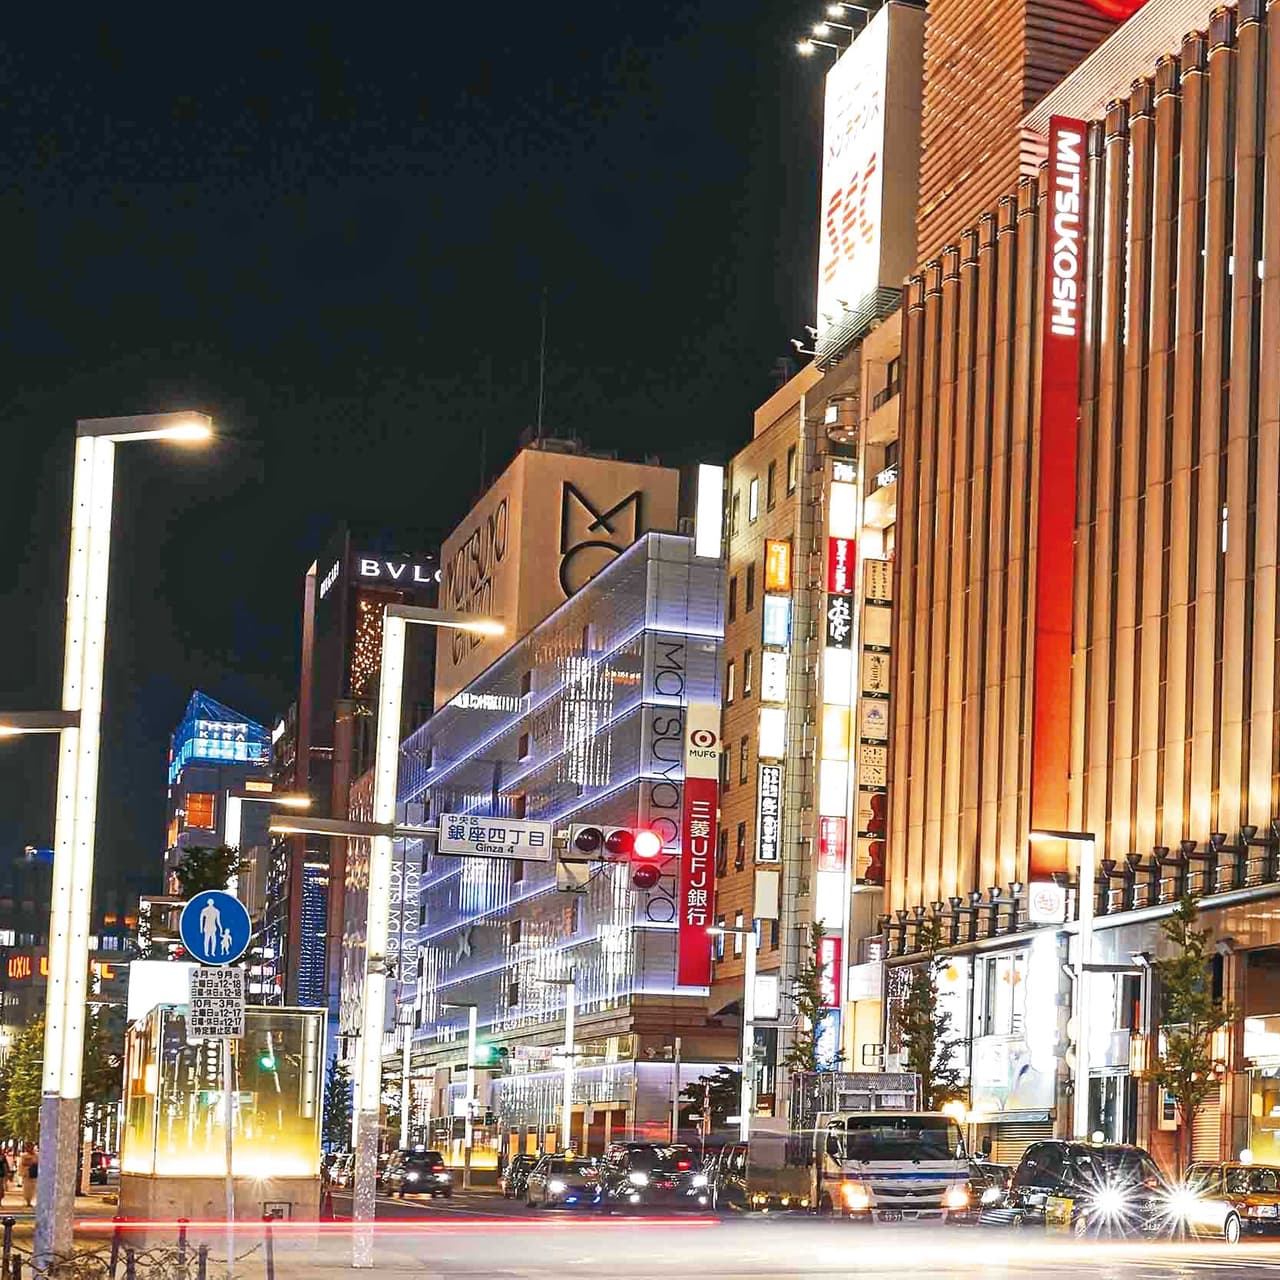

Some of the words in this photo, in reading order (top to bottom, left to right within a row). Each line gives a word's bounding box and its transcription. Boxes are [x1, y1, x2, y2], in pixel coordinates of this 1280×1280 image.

[1051, 130, 1082, 336] MITSUKOSHI
[689, 749, 717, 759] MUFG
[448, 815, 479, 826] 中央区
[447, 824, 545, 847] 銀座四丁目
[475, 843, 505, 854] Ginza
[507, 844, 515, 854] 4
[686, 801, 711, 926] 三菱UFJ銀行
[8, 956, 31, 979] LIXIL
